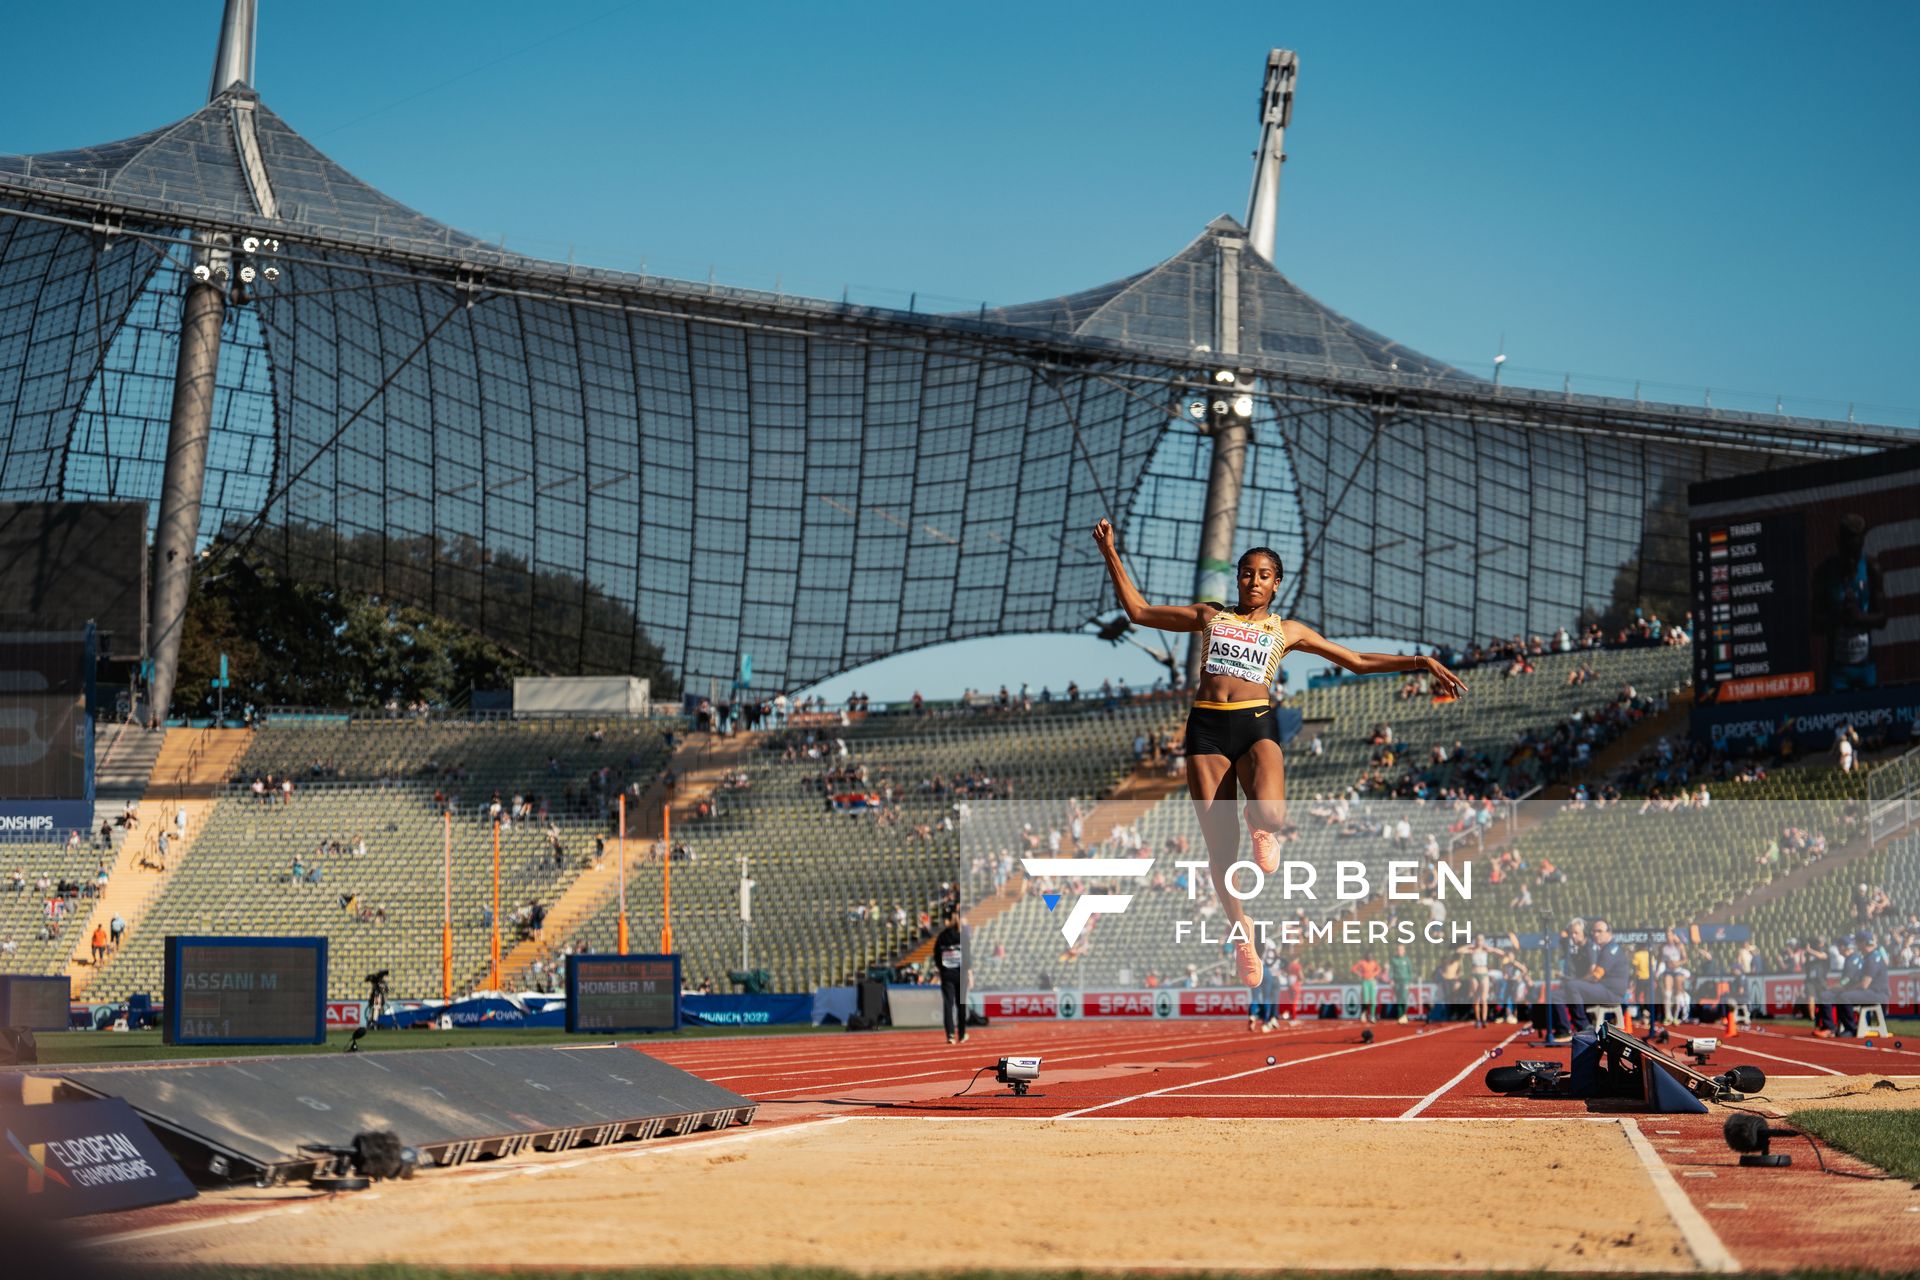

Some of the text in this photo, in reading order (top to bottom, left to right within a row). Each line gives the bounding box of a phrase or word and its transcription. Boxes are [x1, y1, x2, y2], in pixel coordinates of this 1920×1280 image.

[1214, 625, 1257, 642] SPAR
[1210, 642, 1268, 666] ASSANI
[1208, 664, 1262, 682] MUNICH 2022
[1766, 678, 1790, 692] HEAT
[184, 972, 277, 990] ASSANI M
[578, 981, 656, 994] HOMEIER M
[1000, 996, 1057, 1014] SPAR
[1099, 995, 1154, 1013] SPAR
[1195, 994, 1249, 1012] SPAR
[699, 1012, 770, 1023] MUNICH 2022
[47, 1132, 142, 1167] EUROPEAN
[72, 1159, 157, 1187] CHAMPIONSHIPS
